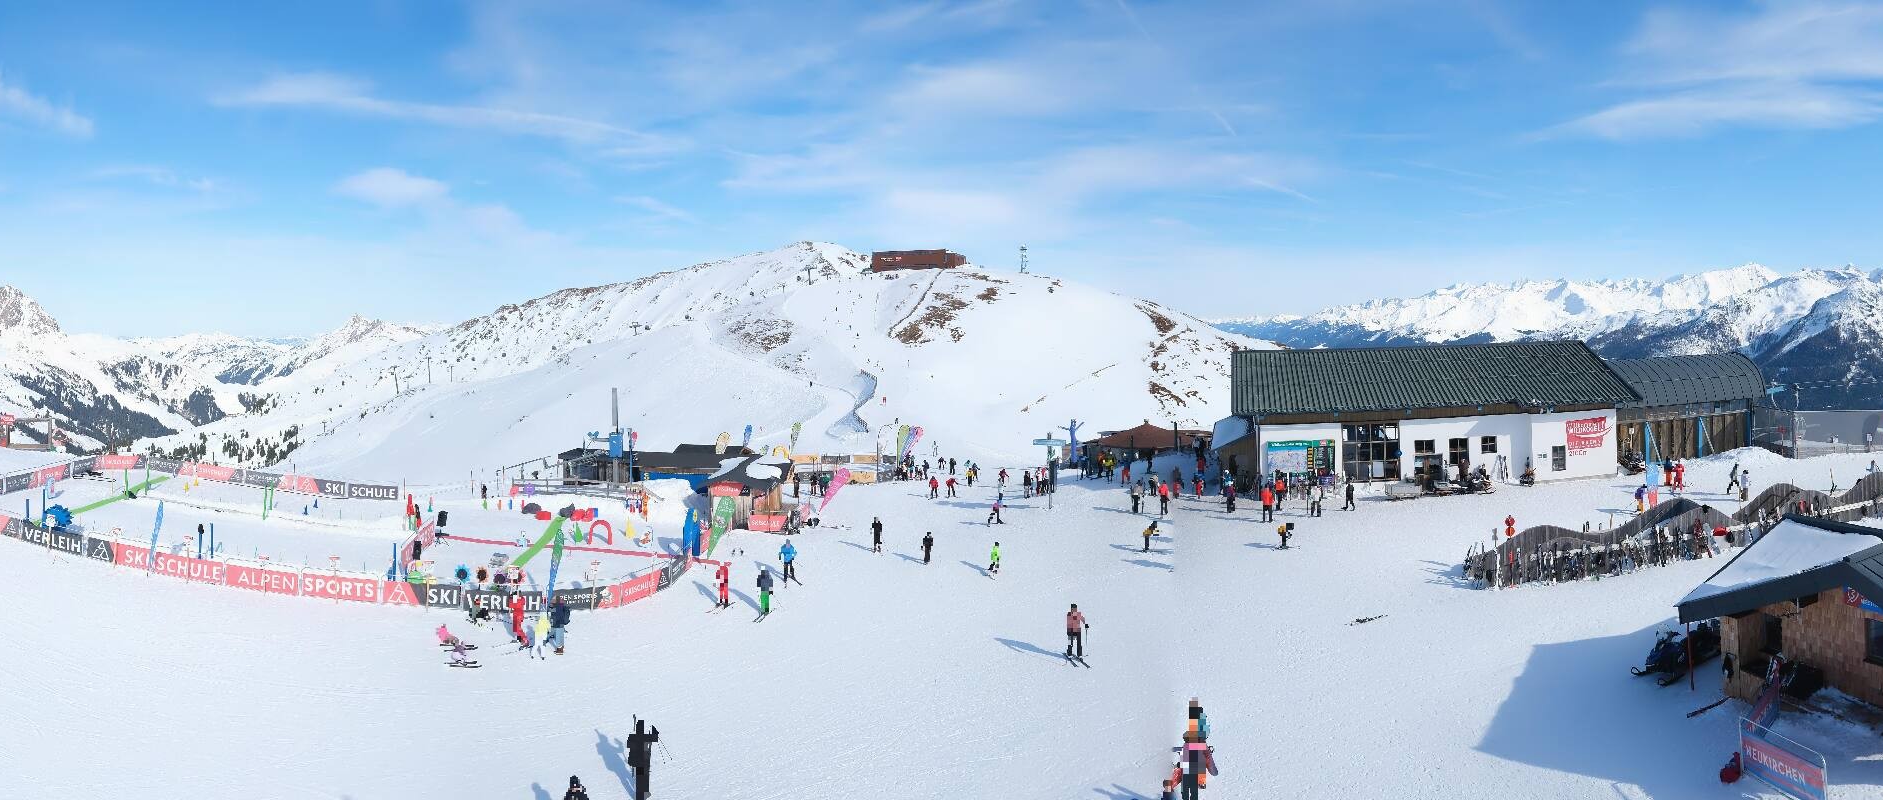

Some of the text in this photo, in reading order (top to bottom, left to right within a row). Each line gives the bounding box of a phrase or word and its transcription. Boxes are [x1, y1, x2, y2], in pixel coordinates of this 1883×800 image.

[325, 482, 396, 499] SKI SCHULE
[24, 526, 82, 553] VERLEIH
[237, 570, 296, 591] ALPEN
[304, 577, 374, 598] SPORTS
[428, 587, 457, 605] SKI
[1745, 744, 1806, 785] NEUKIRCHEN
